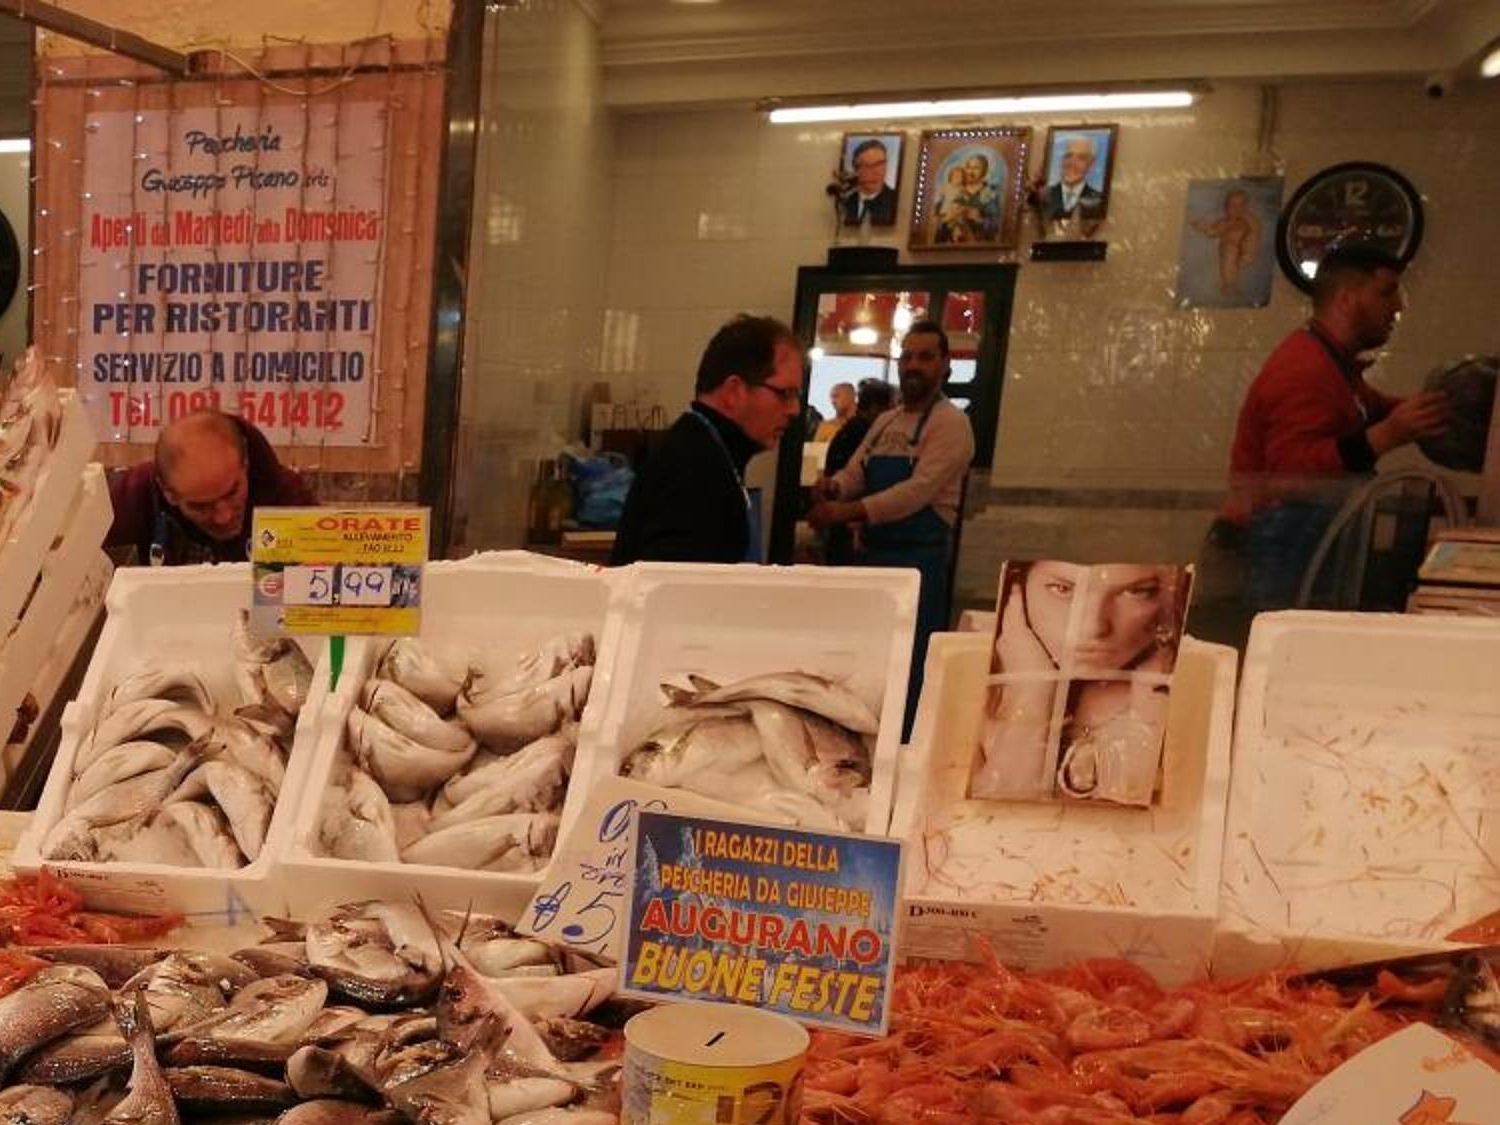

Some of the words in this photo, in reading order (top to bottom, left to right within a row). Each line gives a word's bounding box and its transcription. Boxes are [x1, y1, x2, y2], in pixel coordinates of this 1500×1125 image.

[285, 207, 378, 243] Domenica
[138, 260, 324, 295] FORNITURE
[93, 303, 156, 335] PER
[166, 299, 371, 333] RISTORANTI
[93, 352, 202, 383] SERVIZIO
[210, 352, 226, 383] A
[234, 351, 364, 383] DOMICILIO
[316, 517, 421, 531] ORATE
[705, 832, 779, 864] RAGAZZI
[782, 843, 840, 874] DELLA
[661, 864, 750, 901] PESCHERIA
[757, 880, 782, 905] DA
[787, 883, 872, 918] GIUSEPPE
[641, 898, 883, 966] AUGURANO
[632, 941, 767, 1003] BUONE
[768, 962, 883, 1023] FESTE
